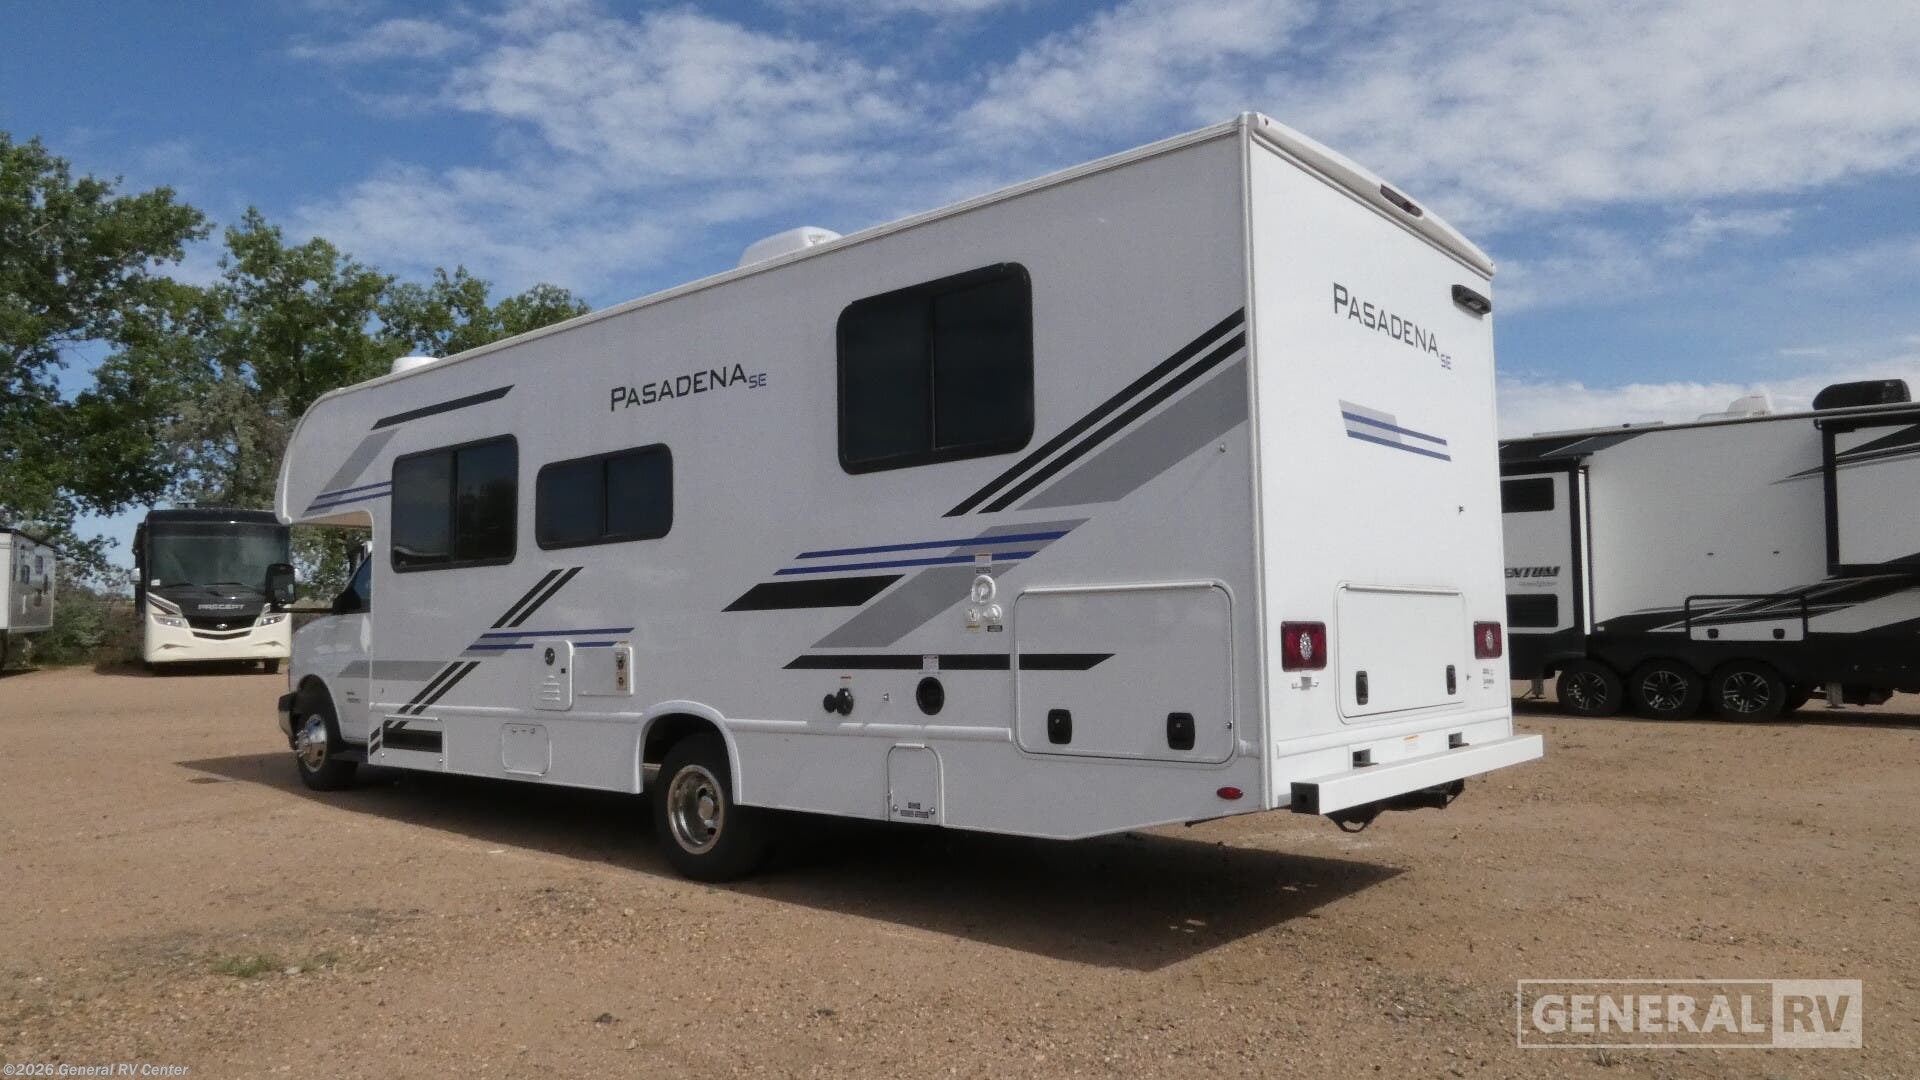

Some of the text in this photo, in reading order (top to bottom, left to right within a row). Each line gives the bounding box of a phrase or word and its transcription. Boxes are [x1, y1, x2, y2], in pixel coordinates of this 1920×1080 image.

[1333, 282, 1452, 370] PASADENA SE
[611, 363, 767, 412] PASADENA SE
